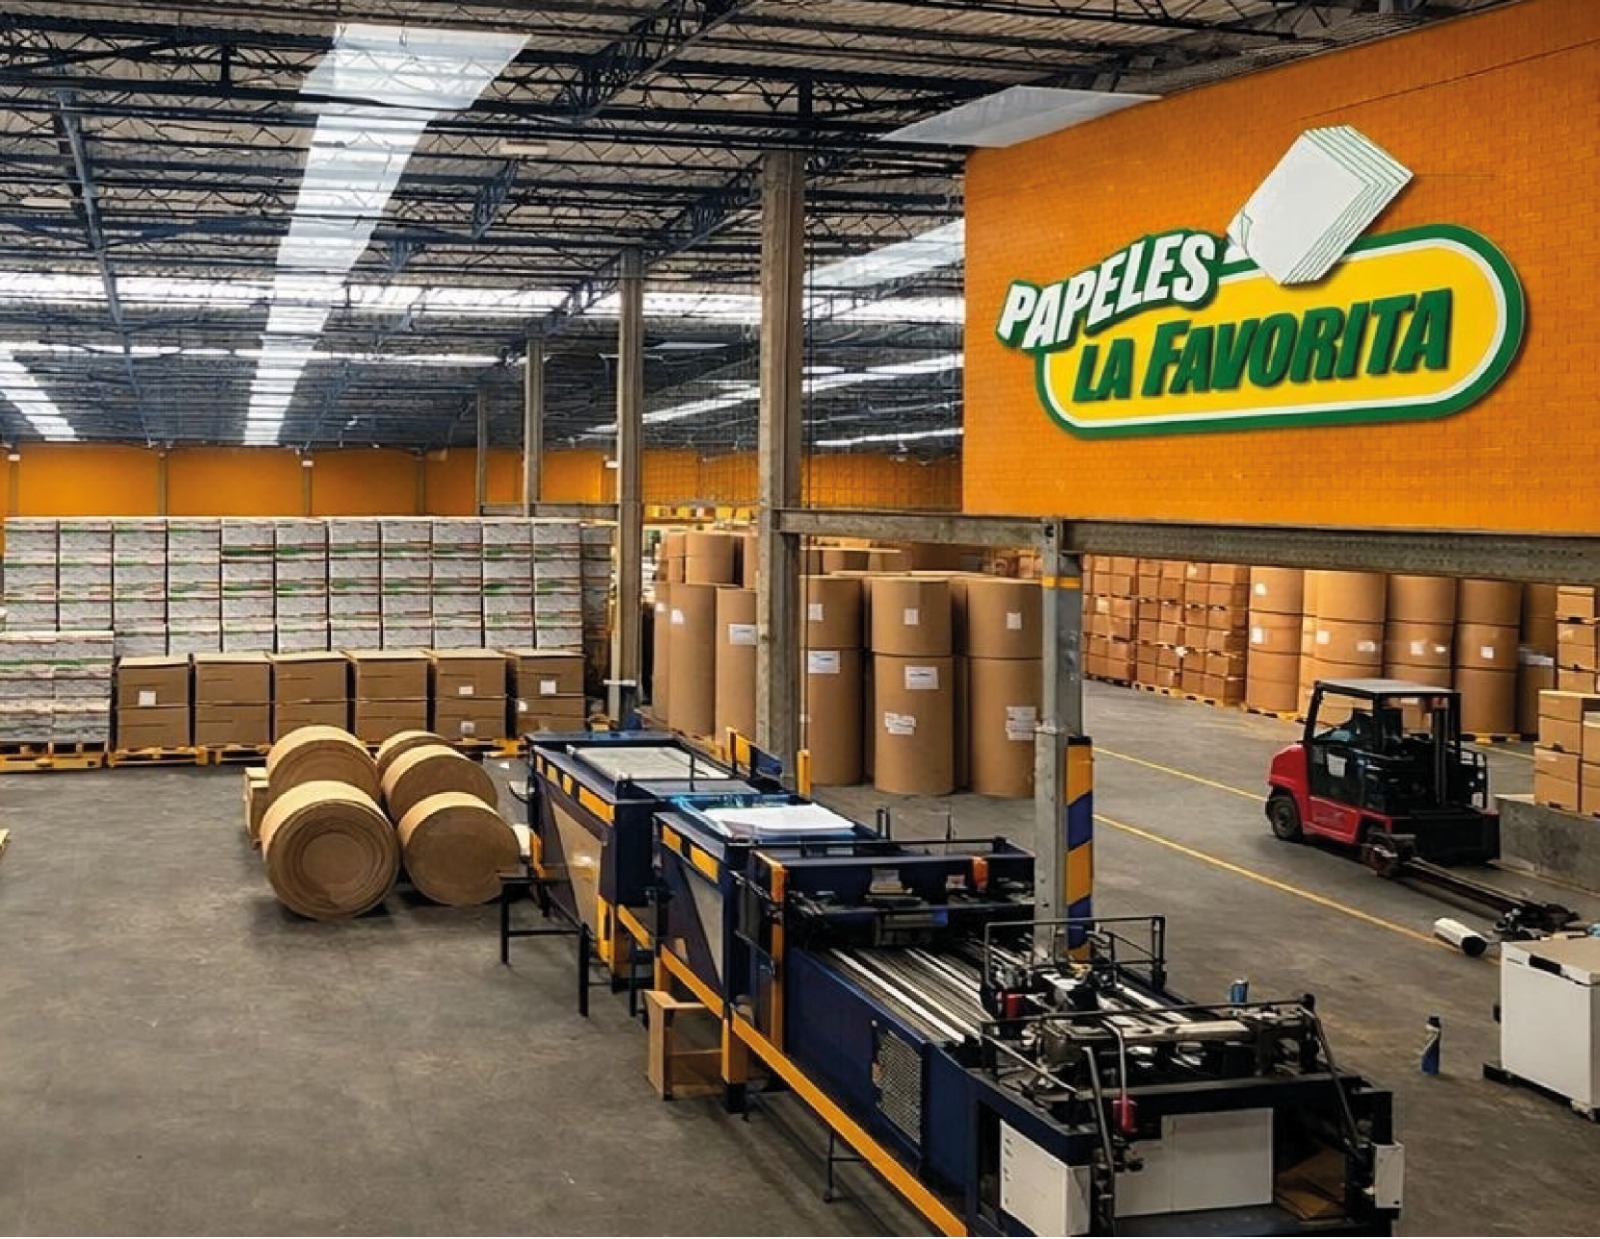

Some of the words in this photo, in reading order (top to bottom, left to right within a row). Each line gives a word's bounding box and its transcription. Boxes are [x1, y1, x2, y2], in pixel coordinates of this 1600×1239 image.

[998, 233, 1215, 348] PAPELES
[1072, 340, 1133, 401] LA
[1141, 288, 1453, 397] FAVORITA
